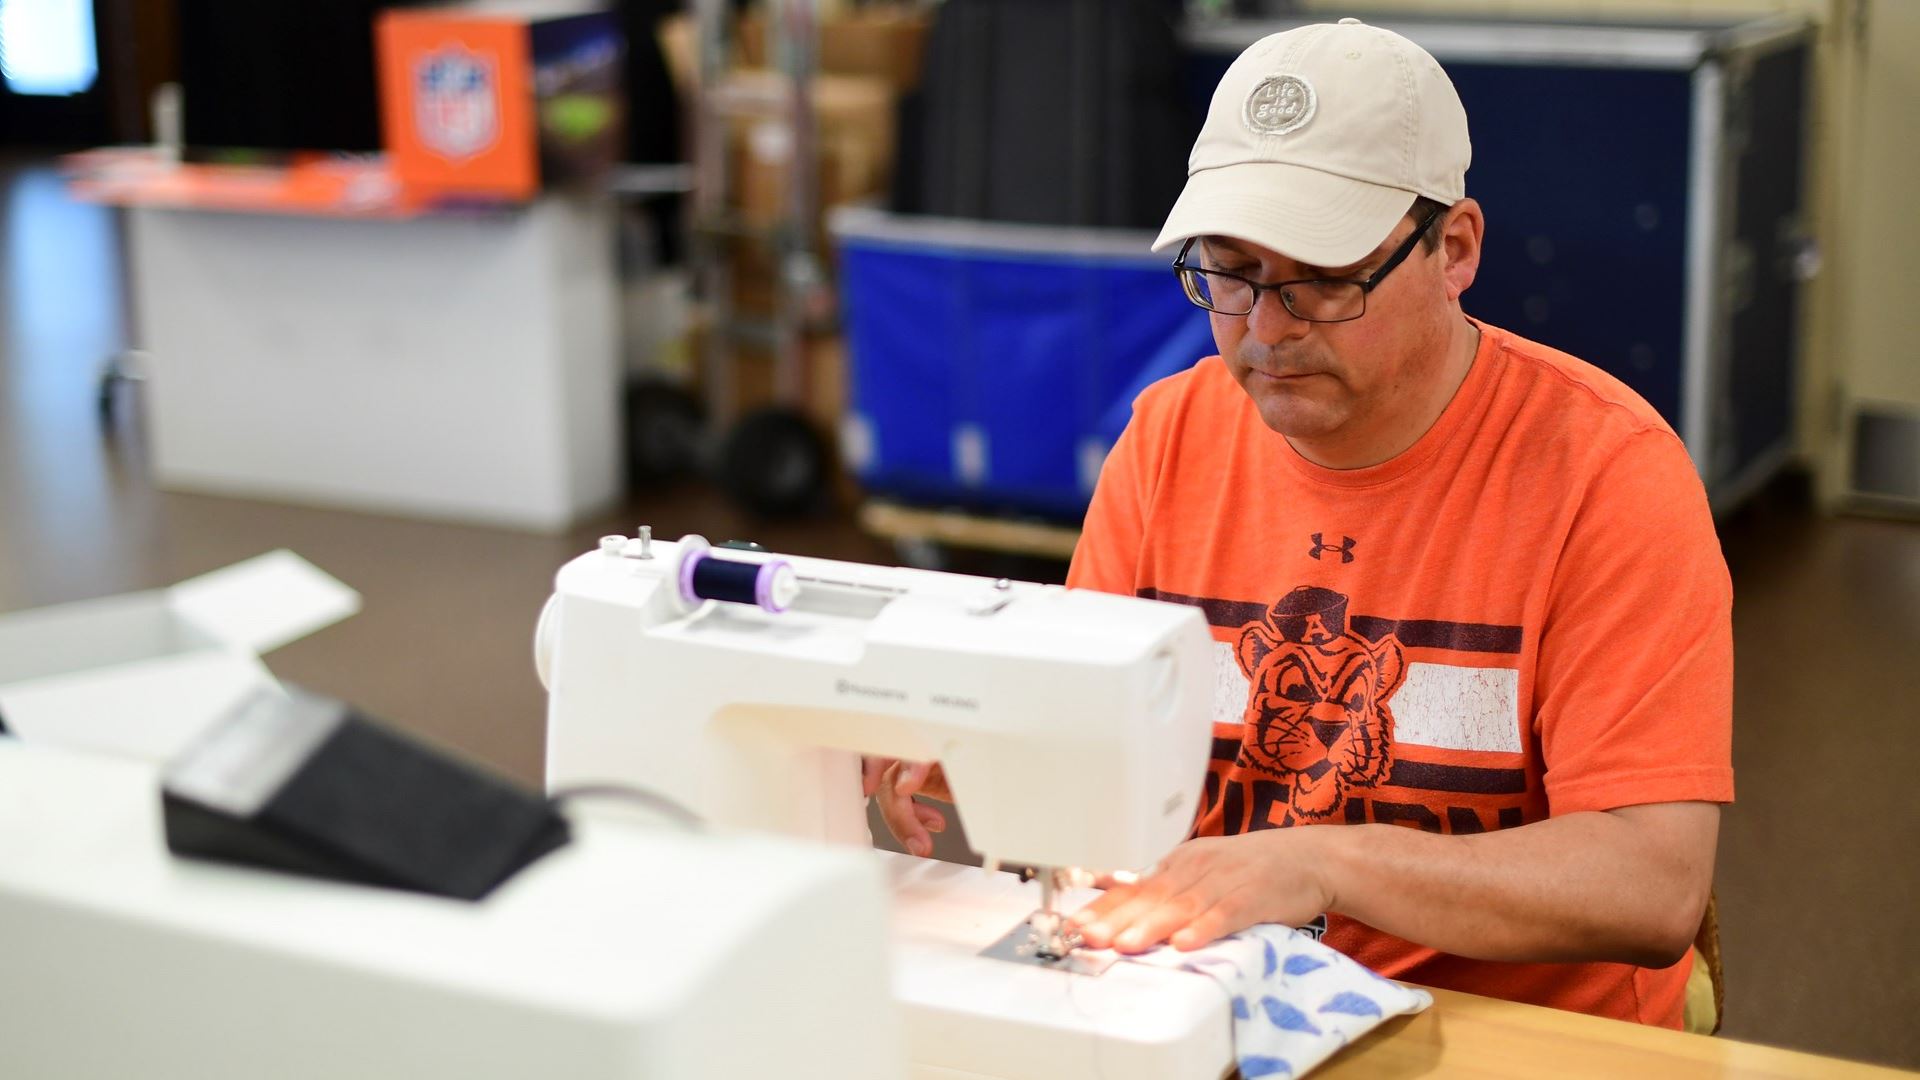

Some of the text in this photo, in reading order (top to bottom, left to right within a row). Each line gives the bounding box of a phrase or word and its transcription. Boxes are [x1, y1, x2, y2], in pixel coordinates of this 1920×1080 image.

[1266, 82, 1295, 98] Life
[1274, 97, 1287, 106] is
[1301, 613, 1332, 642] A
